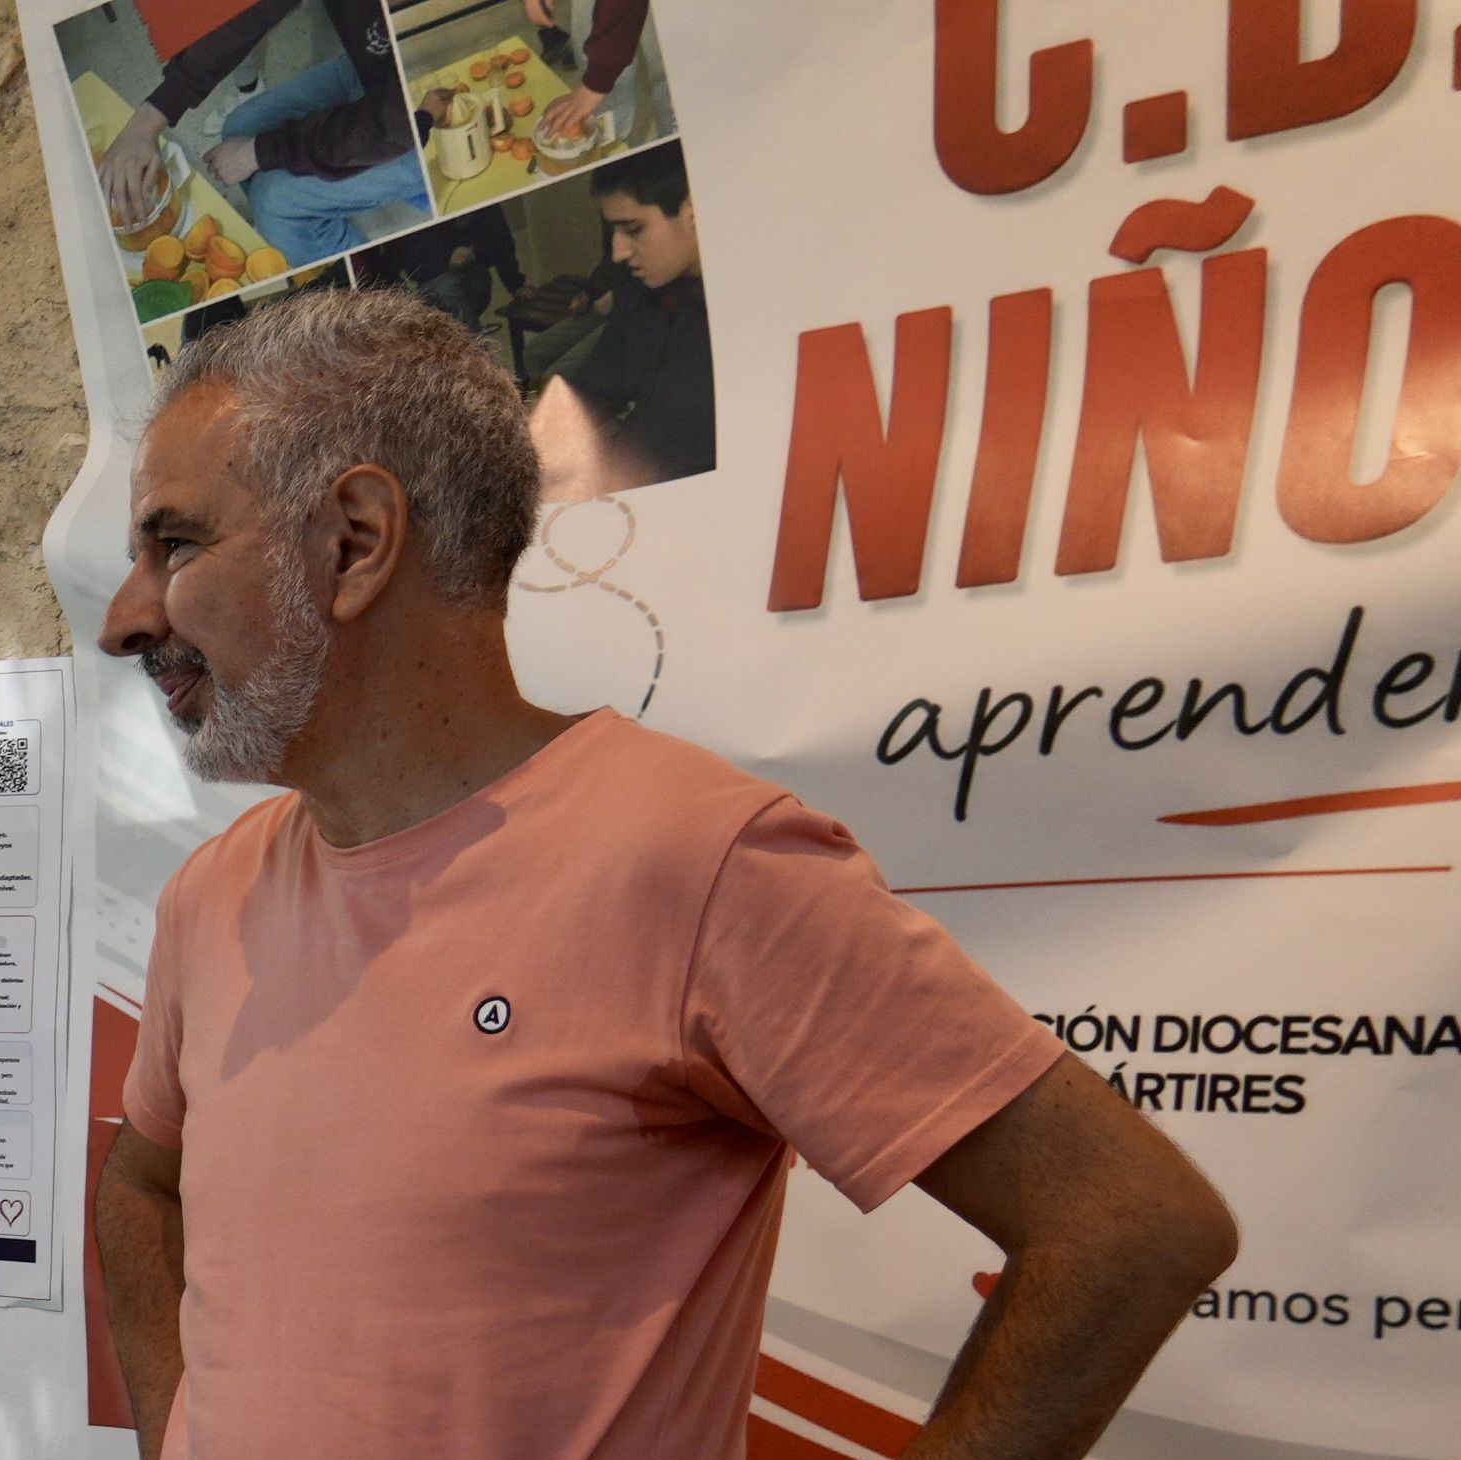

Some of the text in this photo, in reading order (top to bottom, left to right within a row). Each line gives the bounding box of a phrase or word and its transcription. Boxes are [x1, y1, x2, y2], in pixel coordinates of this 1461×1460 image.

[766, 184, 1461, 613] NIÑO
[1152, 1013, 1461, 1056] DIOCESANA
[1375, 1293, 1461, 1339] pe
